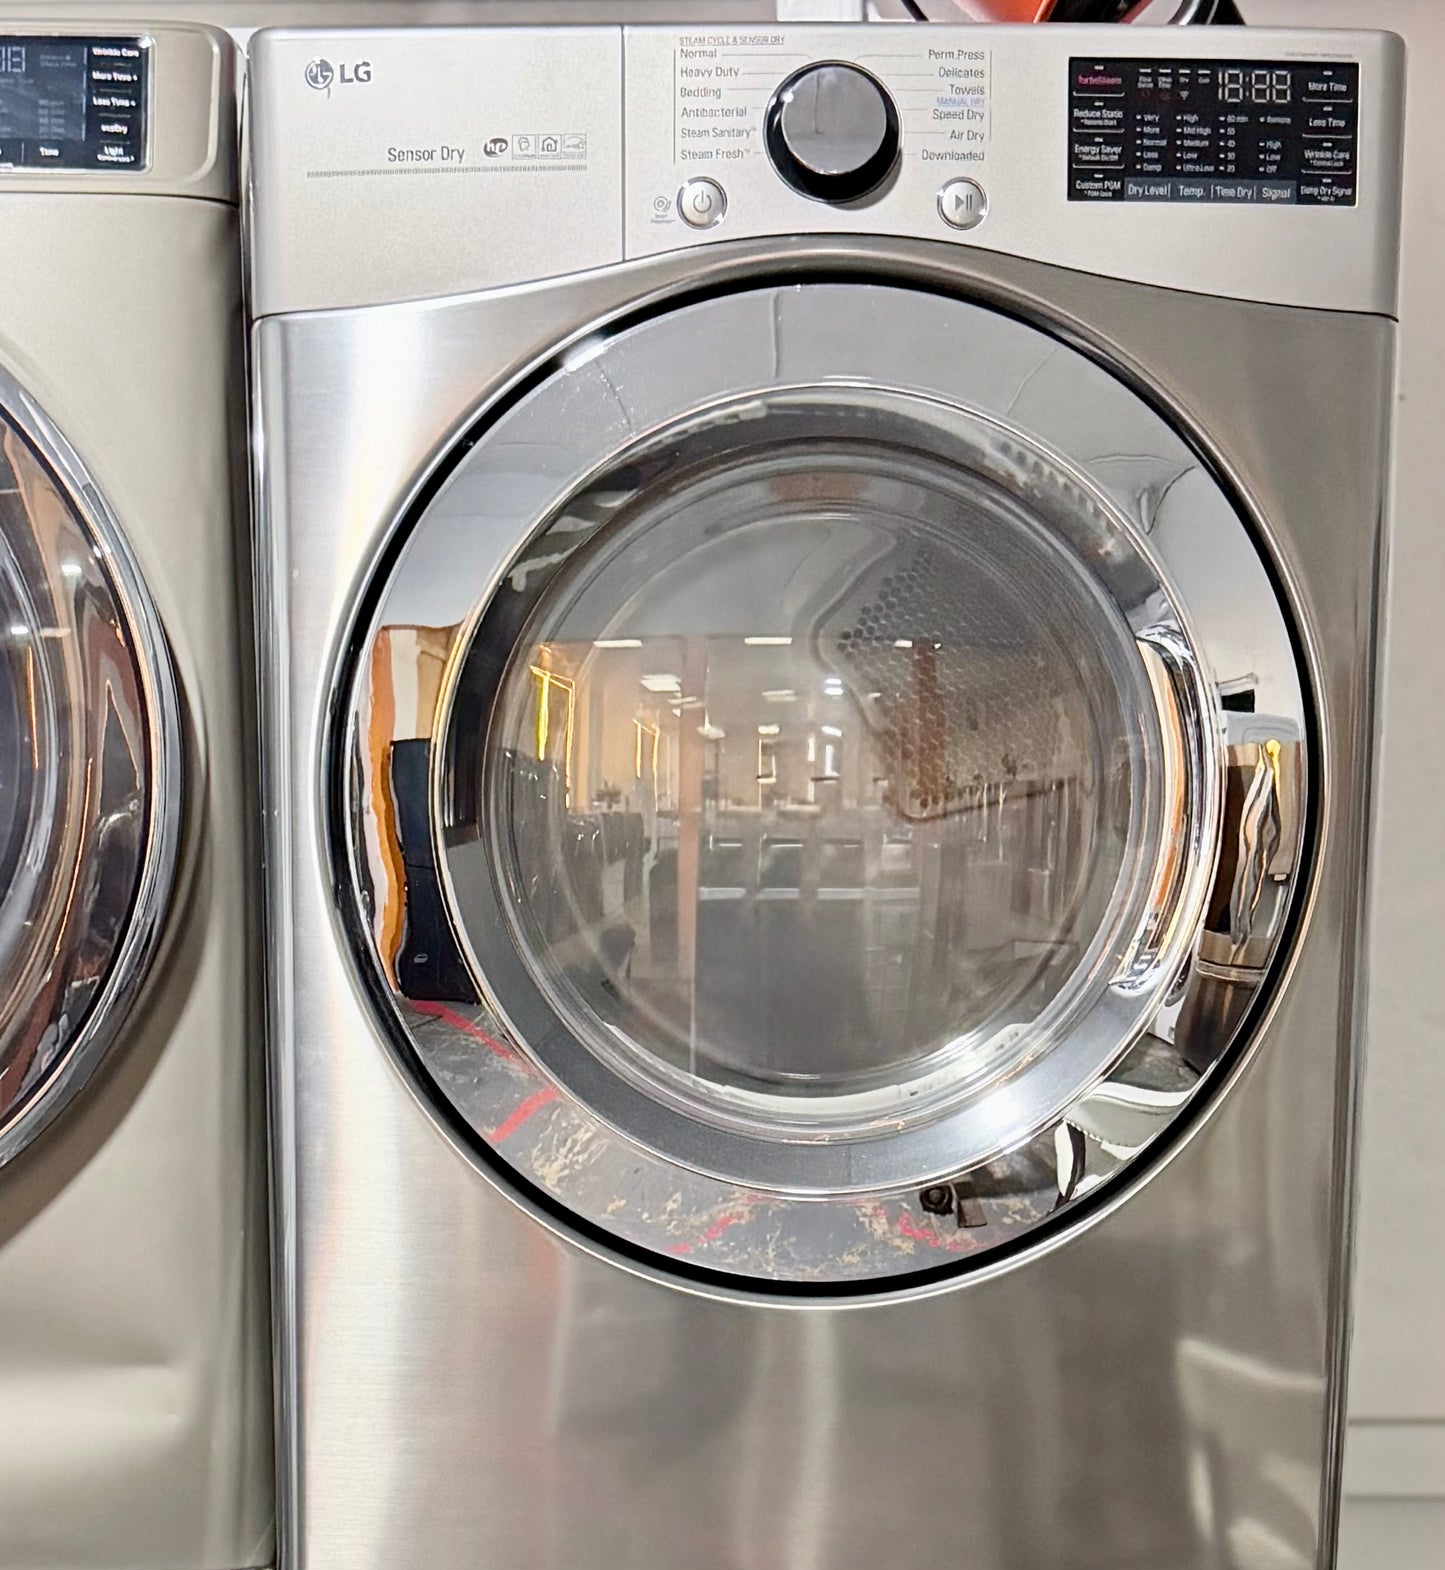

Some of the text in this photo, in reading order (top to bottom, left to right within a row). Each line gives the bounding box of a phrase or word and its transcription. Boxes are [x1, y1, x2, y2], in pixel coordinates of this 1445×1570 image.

[680, 48, 717, 58] Normal
[957, 50, 985, 60] Press
[340, 61, 371, 83] LG
[680, 67, 740, 78] Heavy Duty
[939, 67, 985, 78] Delicates
[950, 84, 985, 96] Towels
[1329, 82, 1347, 92] Time
[680, 87, 721, 99] Bedding
[681, 107, 747, 118] Antibacterial
[932, 109, 985, 122] Speed Dry
[1074, 109, 1123, 119] Reduce Static
[1328, 118, 1346, 128] Time
[681, 128, 710, 139] Steam
[950, 129, 985, 142] Air Dry
[681, 149, 713, 160] Steam
[1074, 144, 1123, 154] Energy Saver
[387, 146, 465, 164] Sensor Dry
[922, 149, 985, 161] Downloaded
[1128, 184, 1168, 196] Dry Level
[1215, 186, 1252, 199] Time Dry
[1262, 188, 1291, 200] Signal
